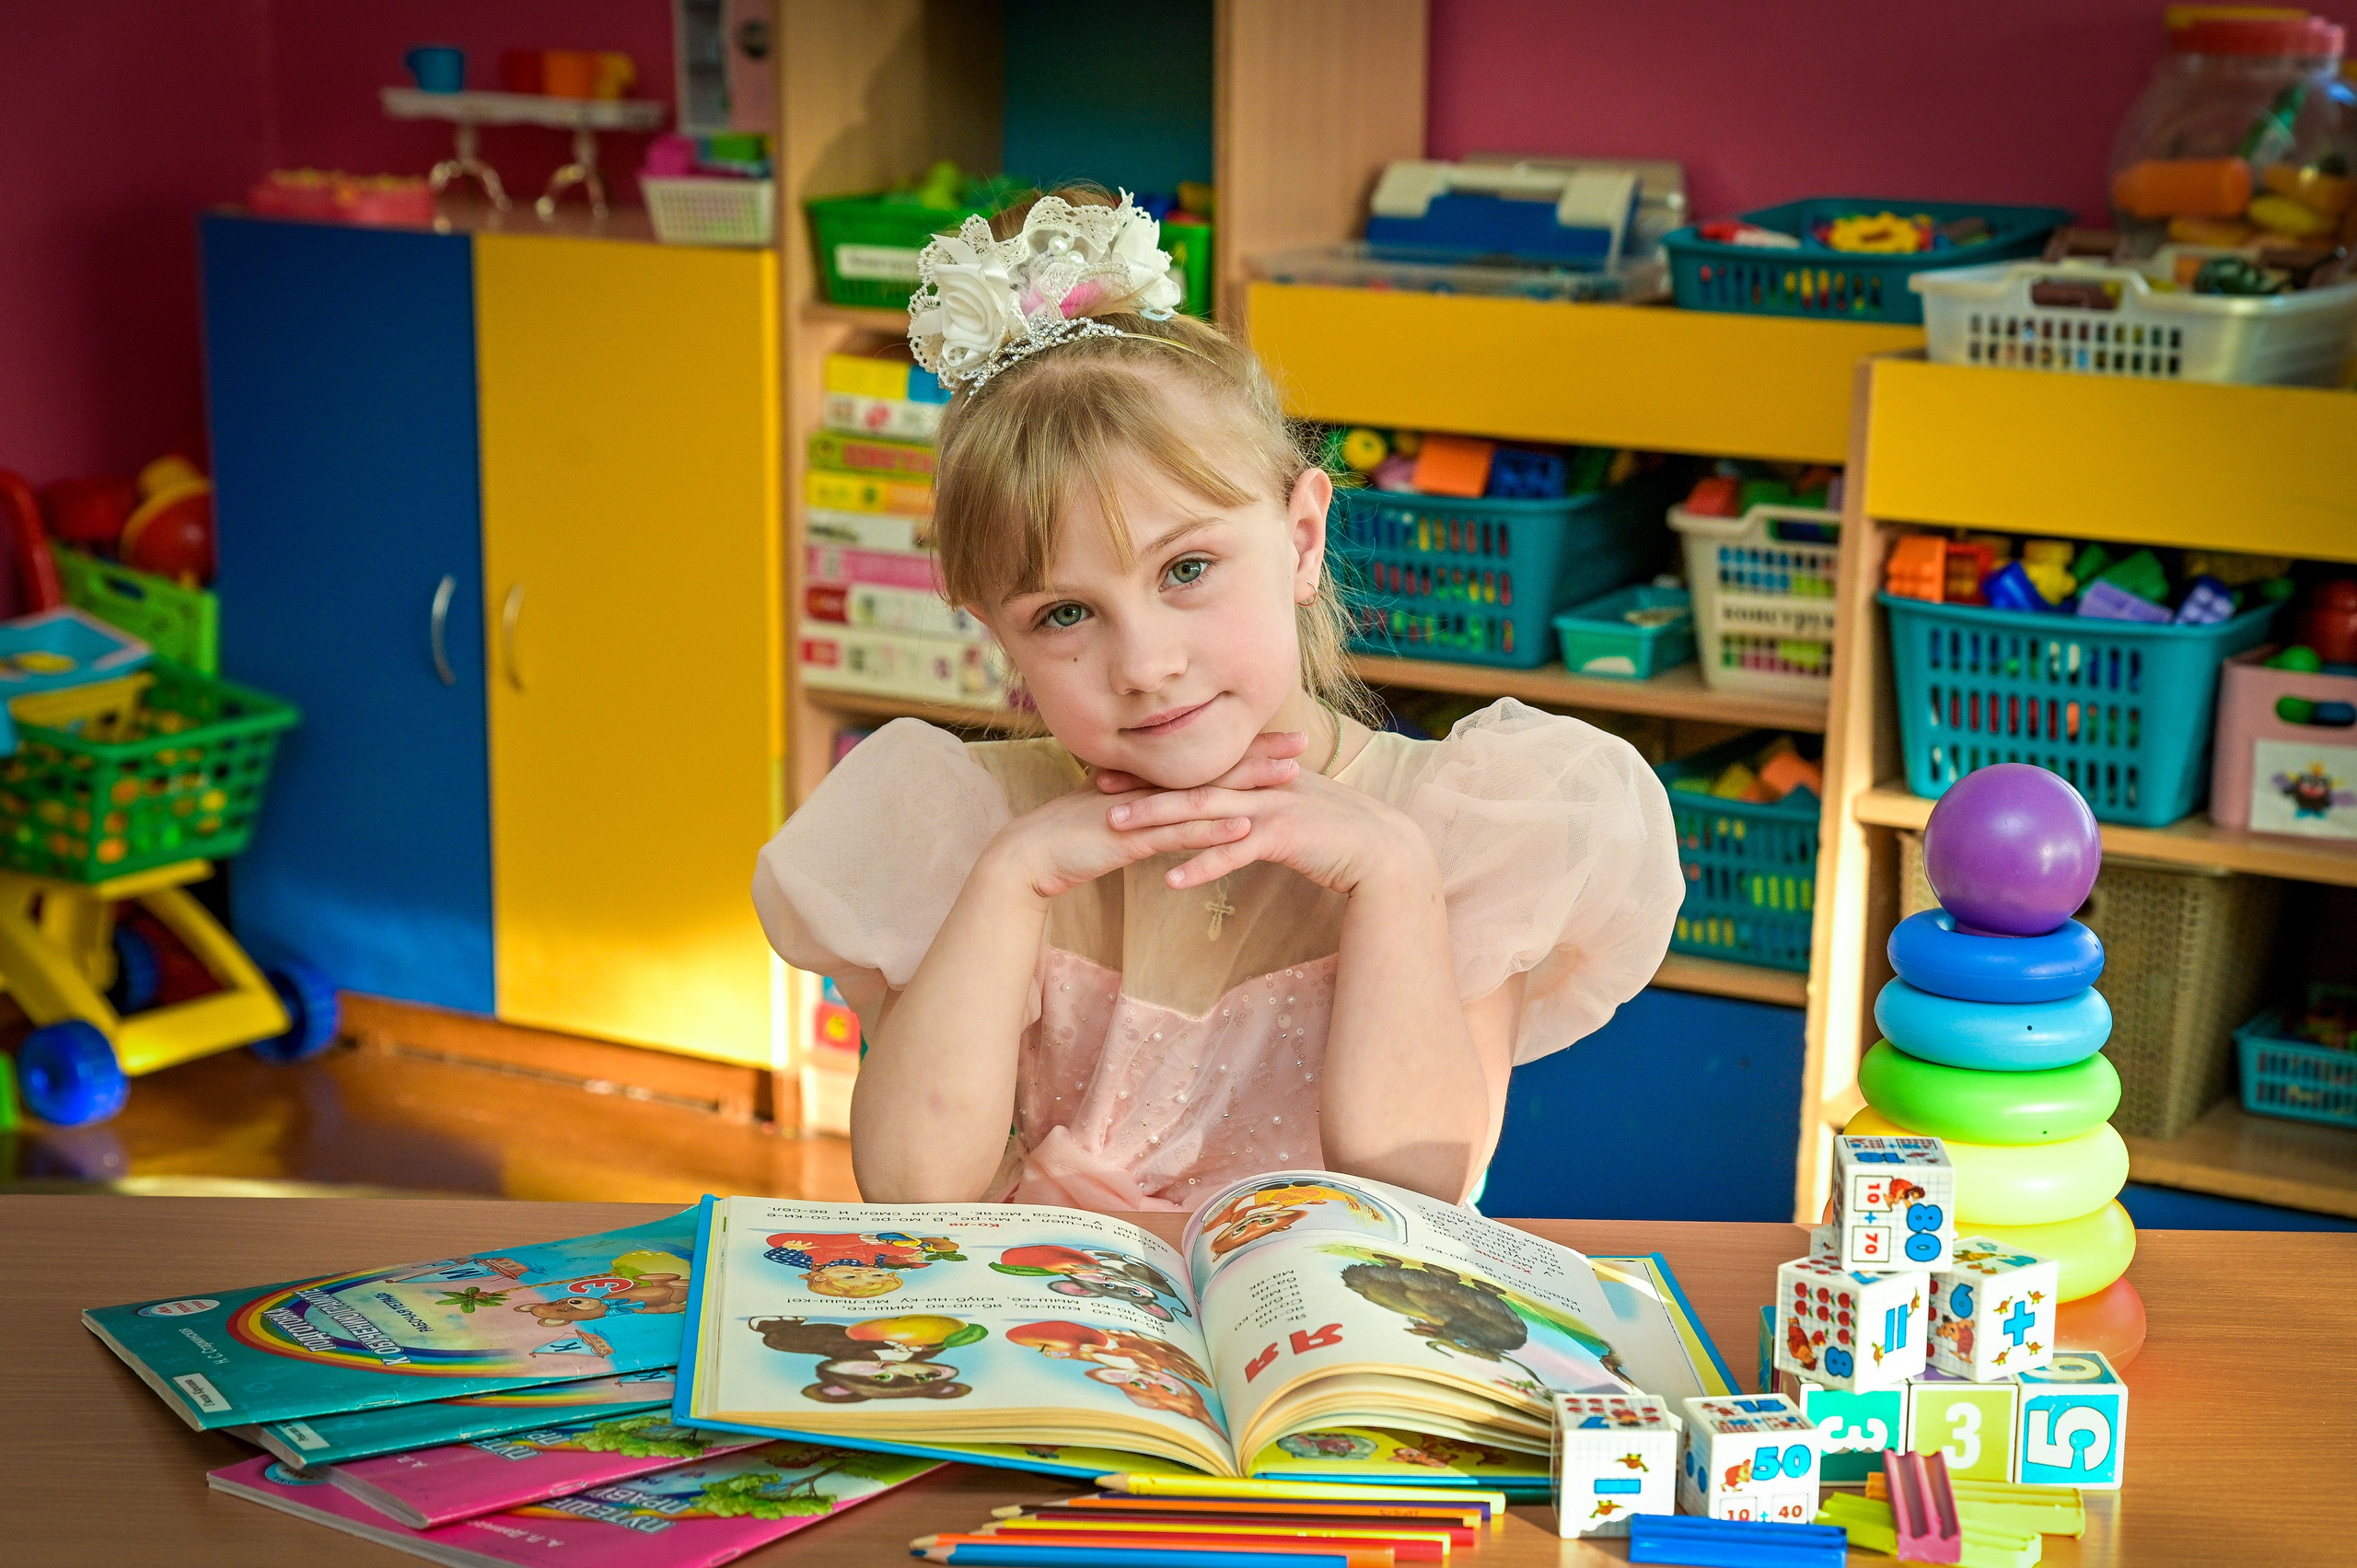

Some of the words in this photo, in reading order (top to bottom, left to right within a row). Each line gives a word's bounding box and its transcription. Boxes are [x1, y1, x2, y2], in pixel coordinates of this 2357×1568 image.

[1867, 1183, 1880, 1203] 10
[1864, 1233, 1878, 1254] 70
[1905, 1203, 1943, 1262] 80
[292, 1287, 352, 1315] ГРАМОТЕ
[259, 1307, 339, 1353] ПОДГОТОВКА
[330, 1308, 404, 1355] ОБУЧЕНИЮ
[396, 1308, 435, 1333] РАБОЧАЯ
[1289, 1323, 1343, 1355] Я
[380, 1355, 413, 1366] К
[1824, 1346, 1854, 1378] 8
[1942, 1402, 1982, 1469] 3
[2026, 1406, 2112, 1472] 5
[1752, 1444, 1812, 1481] 50
[1727, 1508, 1750, 1522] 10
[1778, 1504, 1803, 1518] 40
